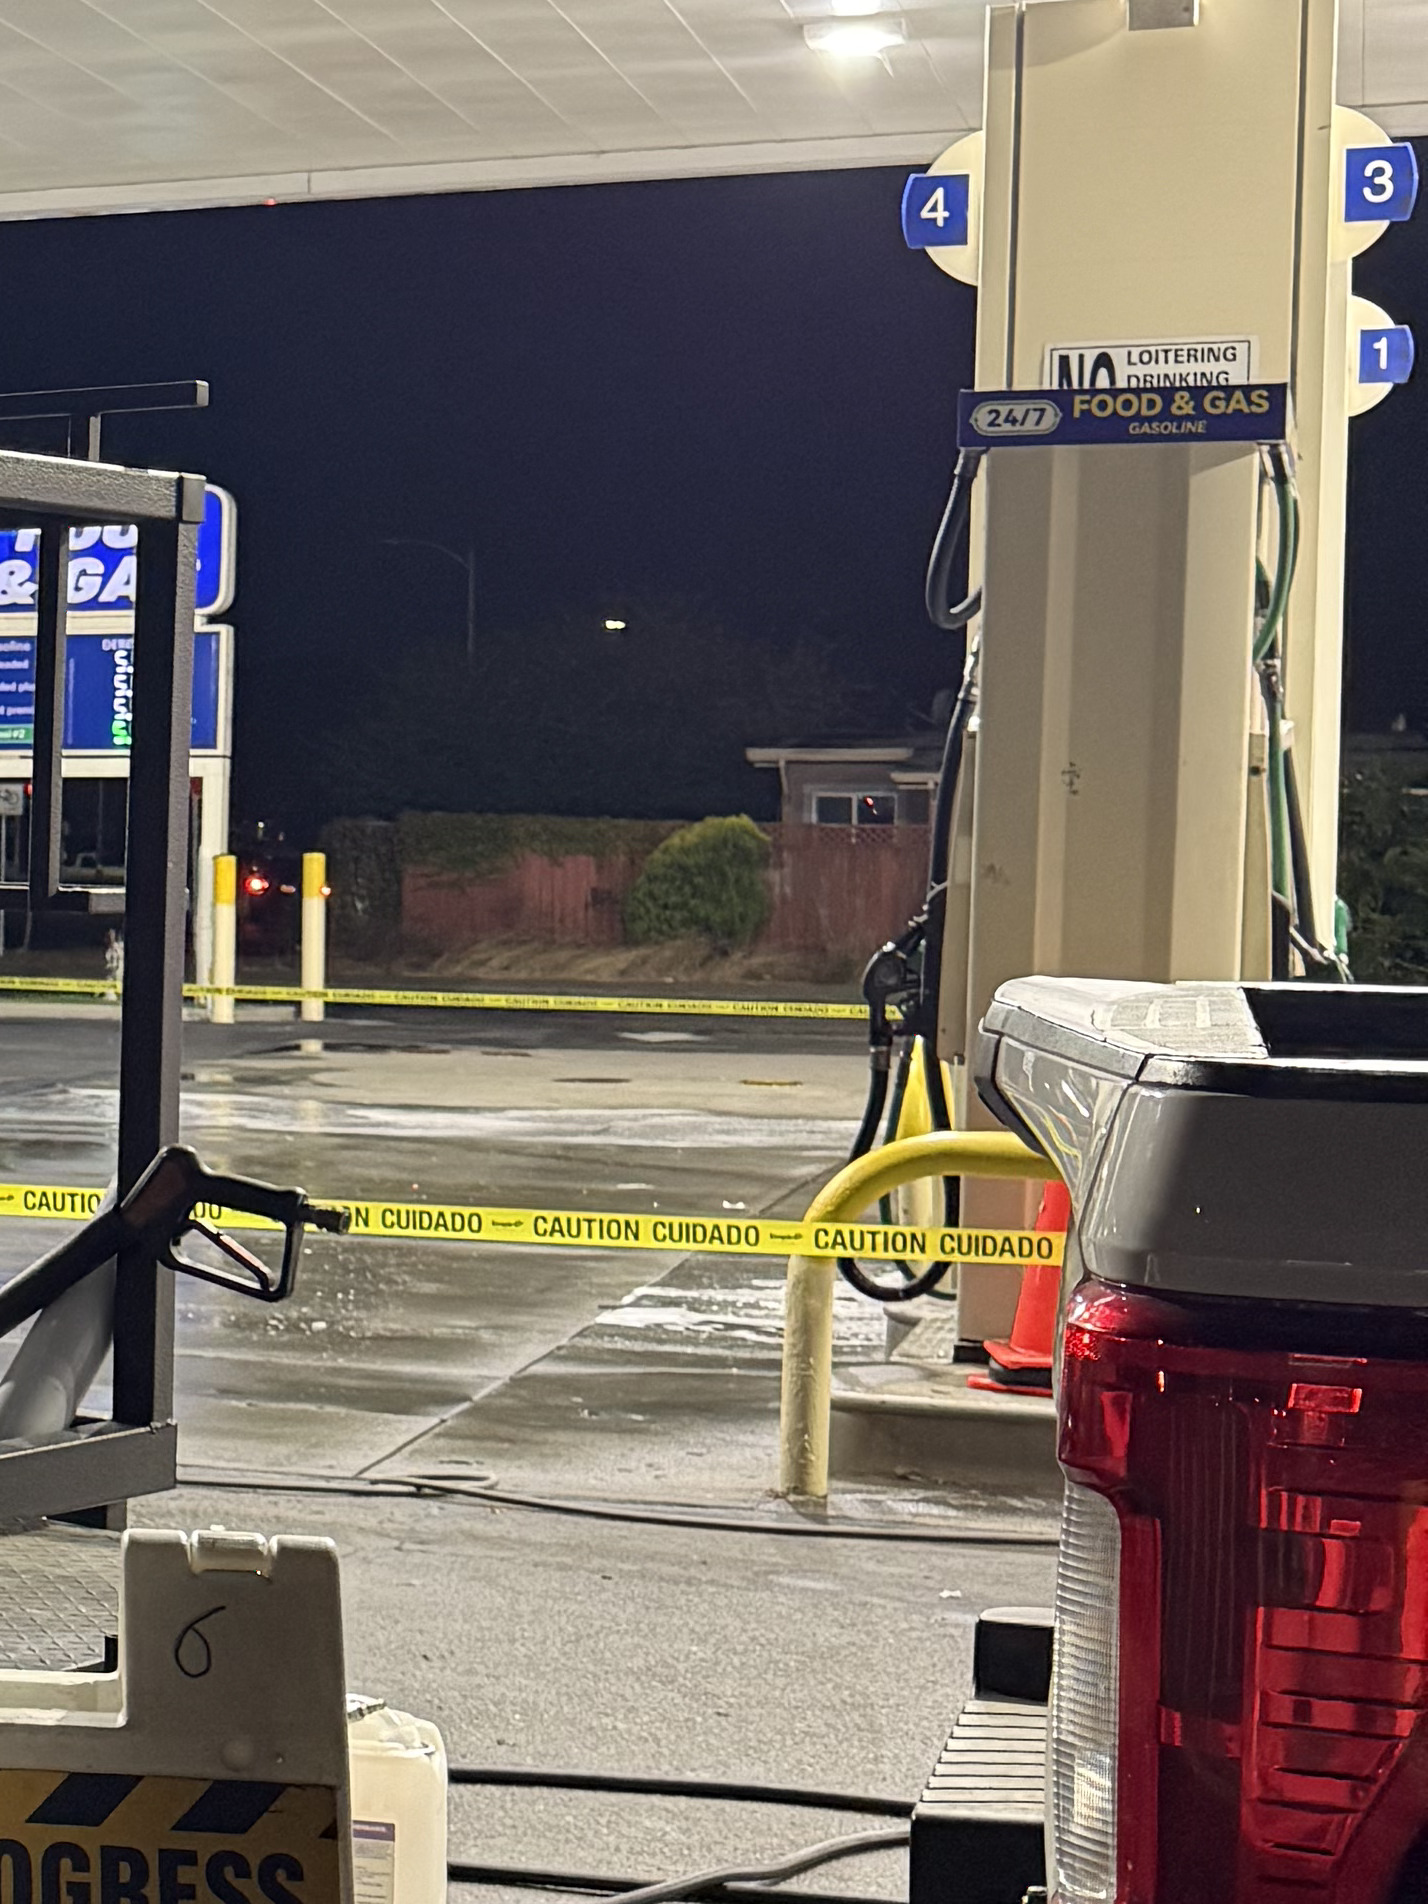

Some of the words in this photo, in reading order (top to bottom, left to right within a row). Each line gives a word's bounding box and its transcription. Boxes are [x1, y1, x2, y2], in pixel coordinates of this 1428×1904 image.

[1362, 160, 1394, 203] 3
[920, 187, 950, 228] 4
[1127, 345, 1237, 367] LOITERING
[1373, 337, 1389, 371] 1
[1127, 370, 1230, 389] DRINKING
[986, 408, 1047, 428] 24/7
[1073, 393, 1163, 419] FOOD
[1171, 390, 1196, 415] &
[1203, 389, 1270, 415] GAS
[1128, 420, 1207, 436] GASOLINE
[23, 1189, 101, 1215] CAUTIO
[381, 1208, 483, 1234] CUIDADO
[533, 1215, 640, 1242] CAUTION
[652, 1221, 761, 1247] CUIDADO
[813, 1227, 927, 1254] CAUTION
[939, 1233, 1054, 1260] CUIDADO
[174, 1606, 219, 1680] 6
